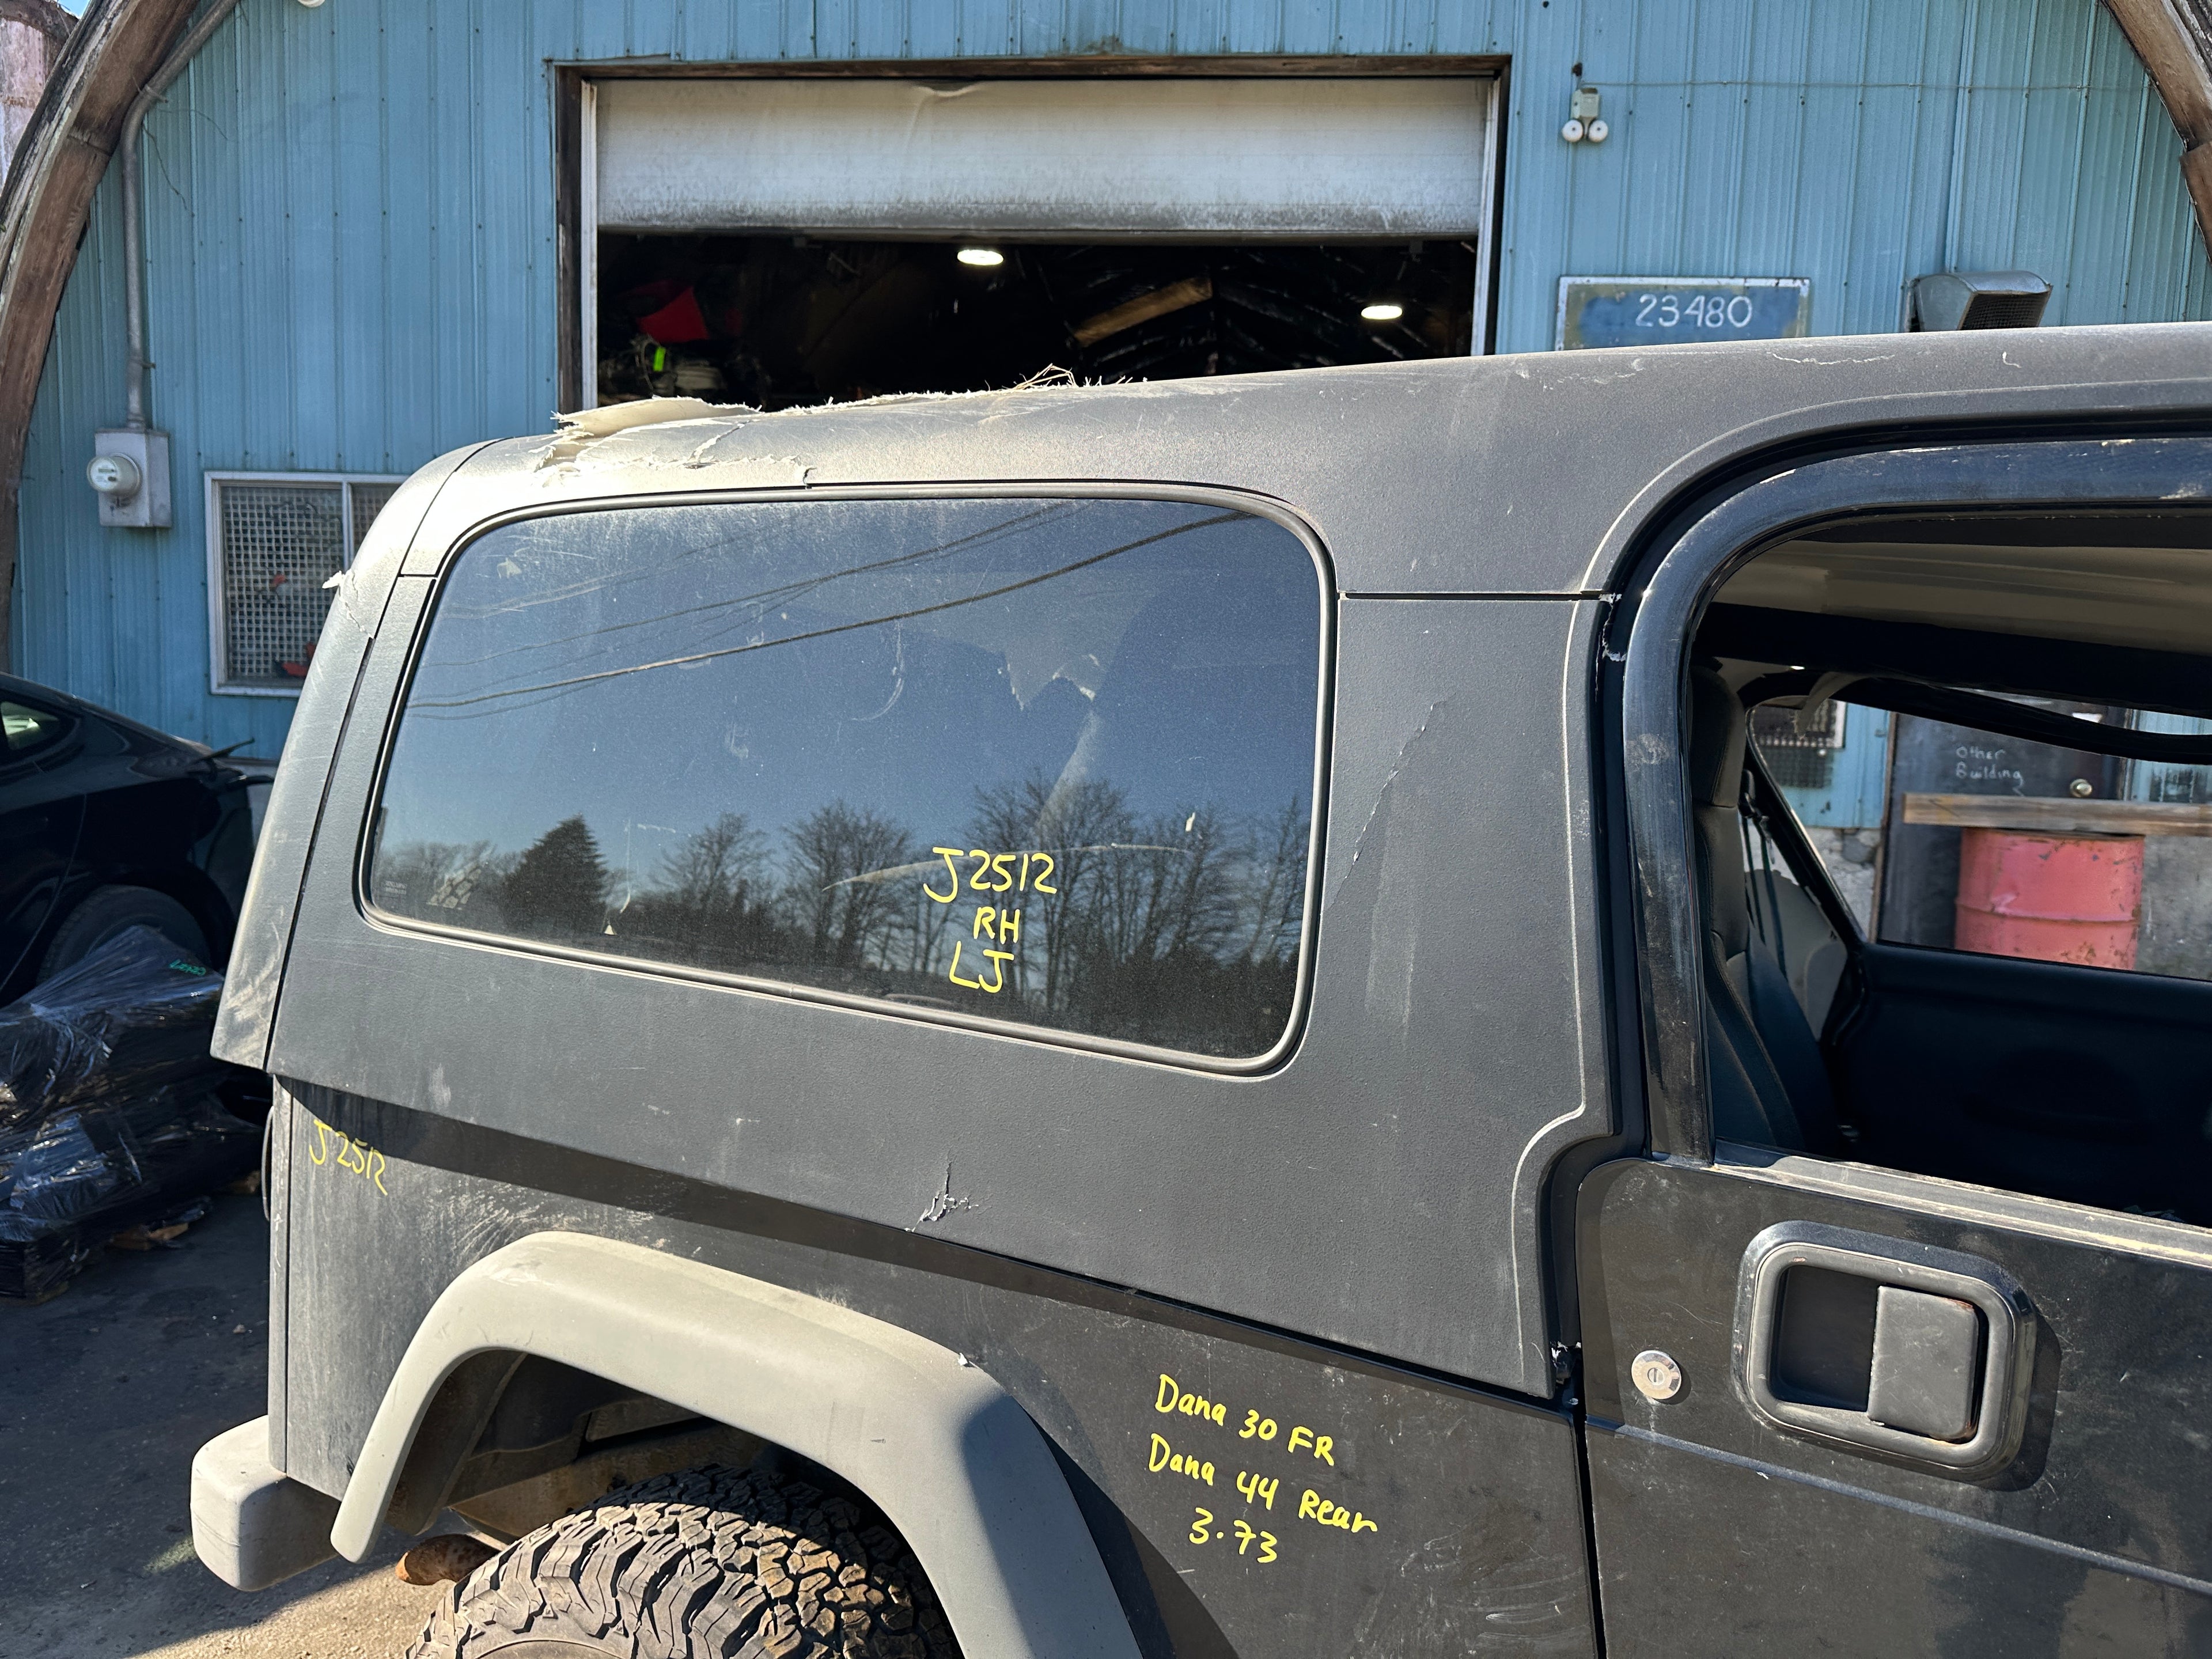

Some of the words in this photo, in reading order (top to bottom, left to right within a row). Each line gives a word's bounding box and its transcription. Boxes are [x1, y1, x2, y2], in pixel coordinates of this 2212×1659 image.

[1635, 294, 1752, 328] 23480
[1956, 746, 2005, 759] Other
[923, 847, 1057, 903] J2512
[973, 906, 1020, 944] RH
[949, 941, 1014, 993] LJ
[1155, 1374, 1227, 1426] Dana
[1238, 1409, 1278, 1441] 30
[1288, 1426, 1335, 1466] FR
[1148, 1433, 1215, 1486] Dana
[1236, 1471, 1279, 1510] 44
[1298, 1488, 1378, 1533] Rear
[1188, 1507, 1278, 1563] 3.73
